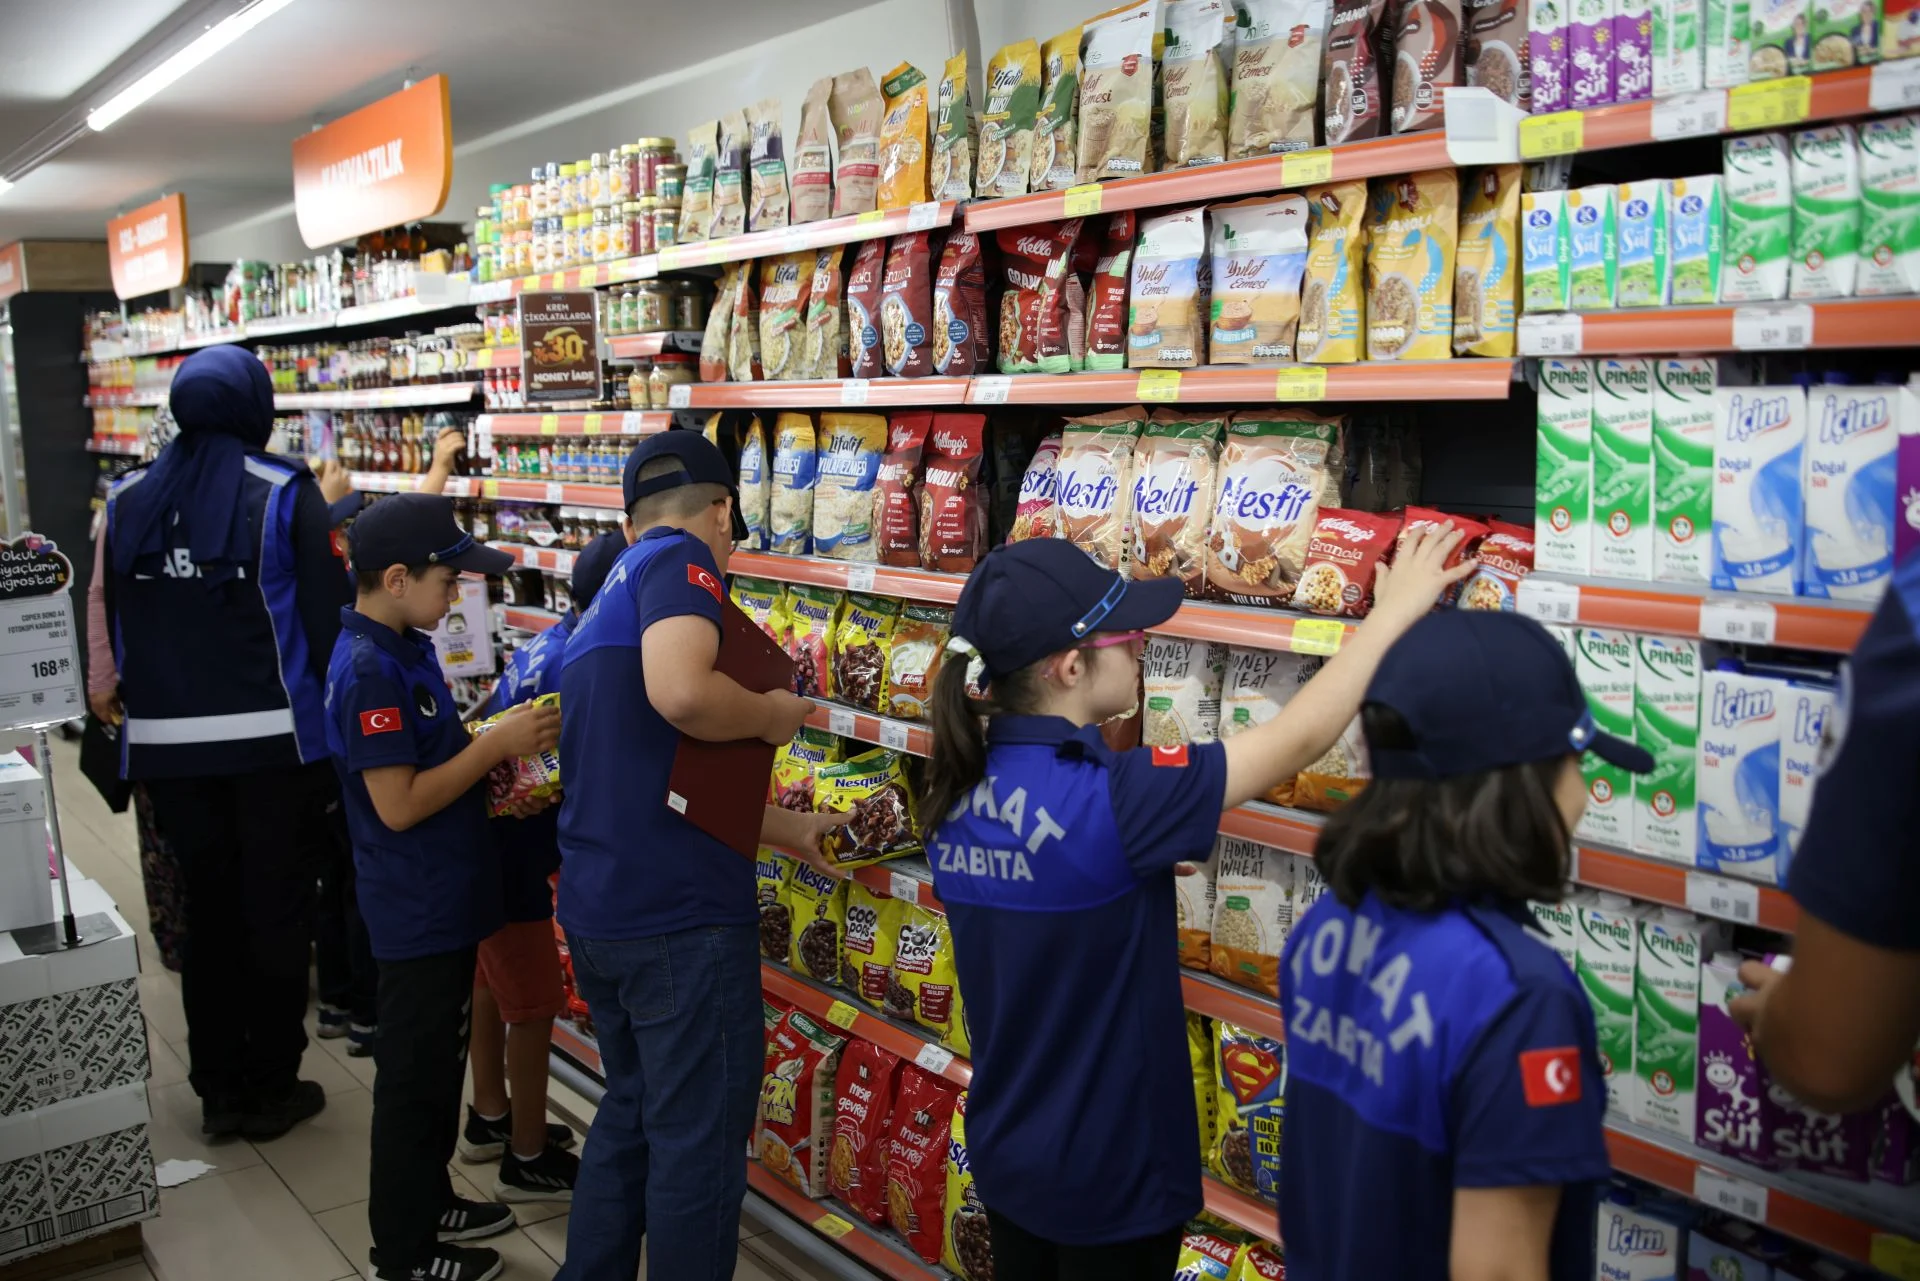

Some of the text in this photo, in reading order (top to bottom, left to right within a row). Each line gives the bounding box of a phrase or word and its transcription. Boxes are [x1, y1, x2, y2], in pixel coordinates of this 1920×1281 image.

[1574, 74, 1609, 101] Süt
[1017, 236, 1052, 257] Kello
[1224, 259, 1268, 278] Yulaf
[523, 311, 592, 323] ÇİKOLATALARDA
[545, 303, 569, 312] KREM
[533, 371, 570, 382] MONEY
[1550, 370, 1588, 384] PINAR
[1605, 370, 1648, 384] PINAR
[1666, 371, 1711, 385] PINAR
[1726, 393, 1789, 443] İçim
[1820, 393, 1887, 445] İçim
[828, 434, 866, 456] Lifalif
[1719, 457, 1752, 474] Doğal
[1811, 460, 1847, 476] Doğal
[1216, 474, 1313, 522] Nesfit
[1318, 517, 1376, 541] Kellogg's
[1310, 539, 1363, 560] Granola
[1470, 551, 1529, 576] Granola
[1145, 642, 1193, 662] HONEY
[1588, 640, 1630, 657] PINAR
[1650, 649, 1694, 667] PINAR
[1712, 681, 1773, 728] İçim
[1794, 697, 1831, 746] İçi
[788, 742, 826, 763] Nesquik
[1704, 741, 1737, 755] Doğal
[835, 771, 891, 788] Nesquik
[1224, 841, 1264, 860] HONEY
[756, 861, 784, 881] quik
[937, 843, 1034, 882] ZABITA
[1220, 860, 1264, 878] WHEAT
[1534, 905, 1572, 925] PINAR
[1589, 919, 1630, 940] PINAR
[1651, 934, 1694, 957] PINAR
[860, 1065, 868, 1079] M
[915, 1110, 929, 1126] M
[1704, 1107, 1763, 1150] Süt
[1772, 1128, 1849, 1162] Süt
[1608, 1214, 1665, 1256] İçim
[1601, 1263, 1631, 1280] Doğal
